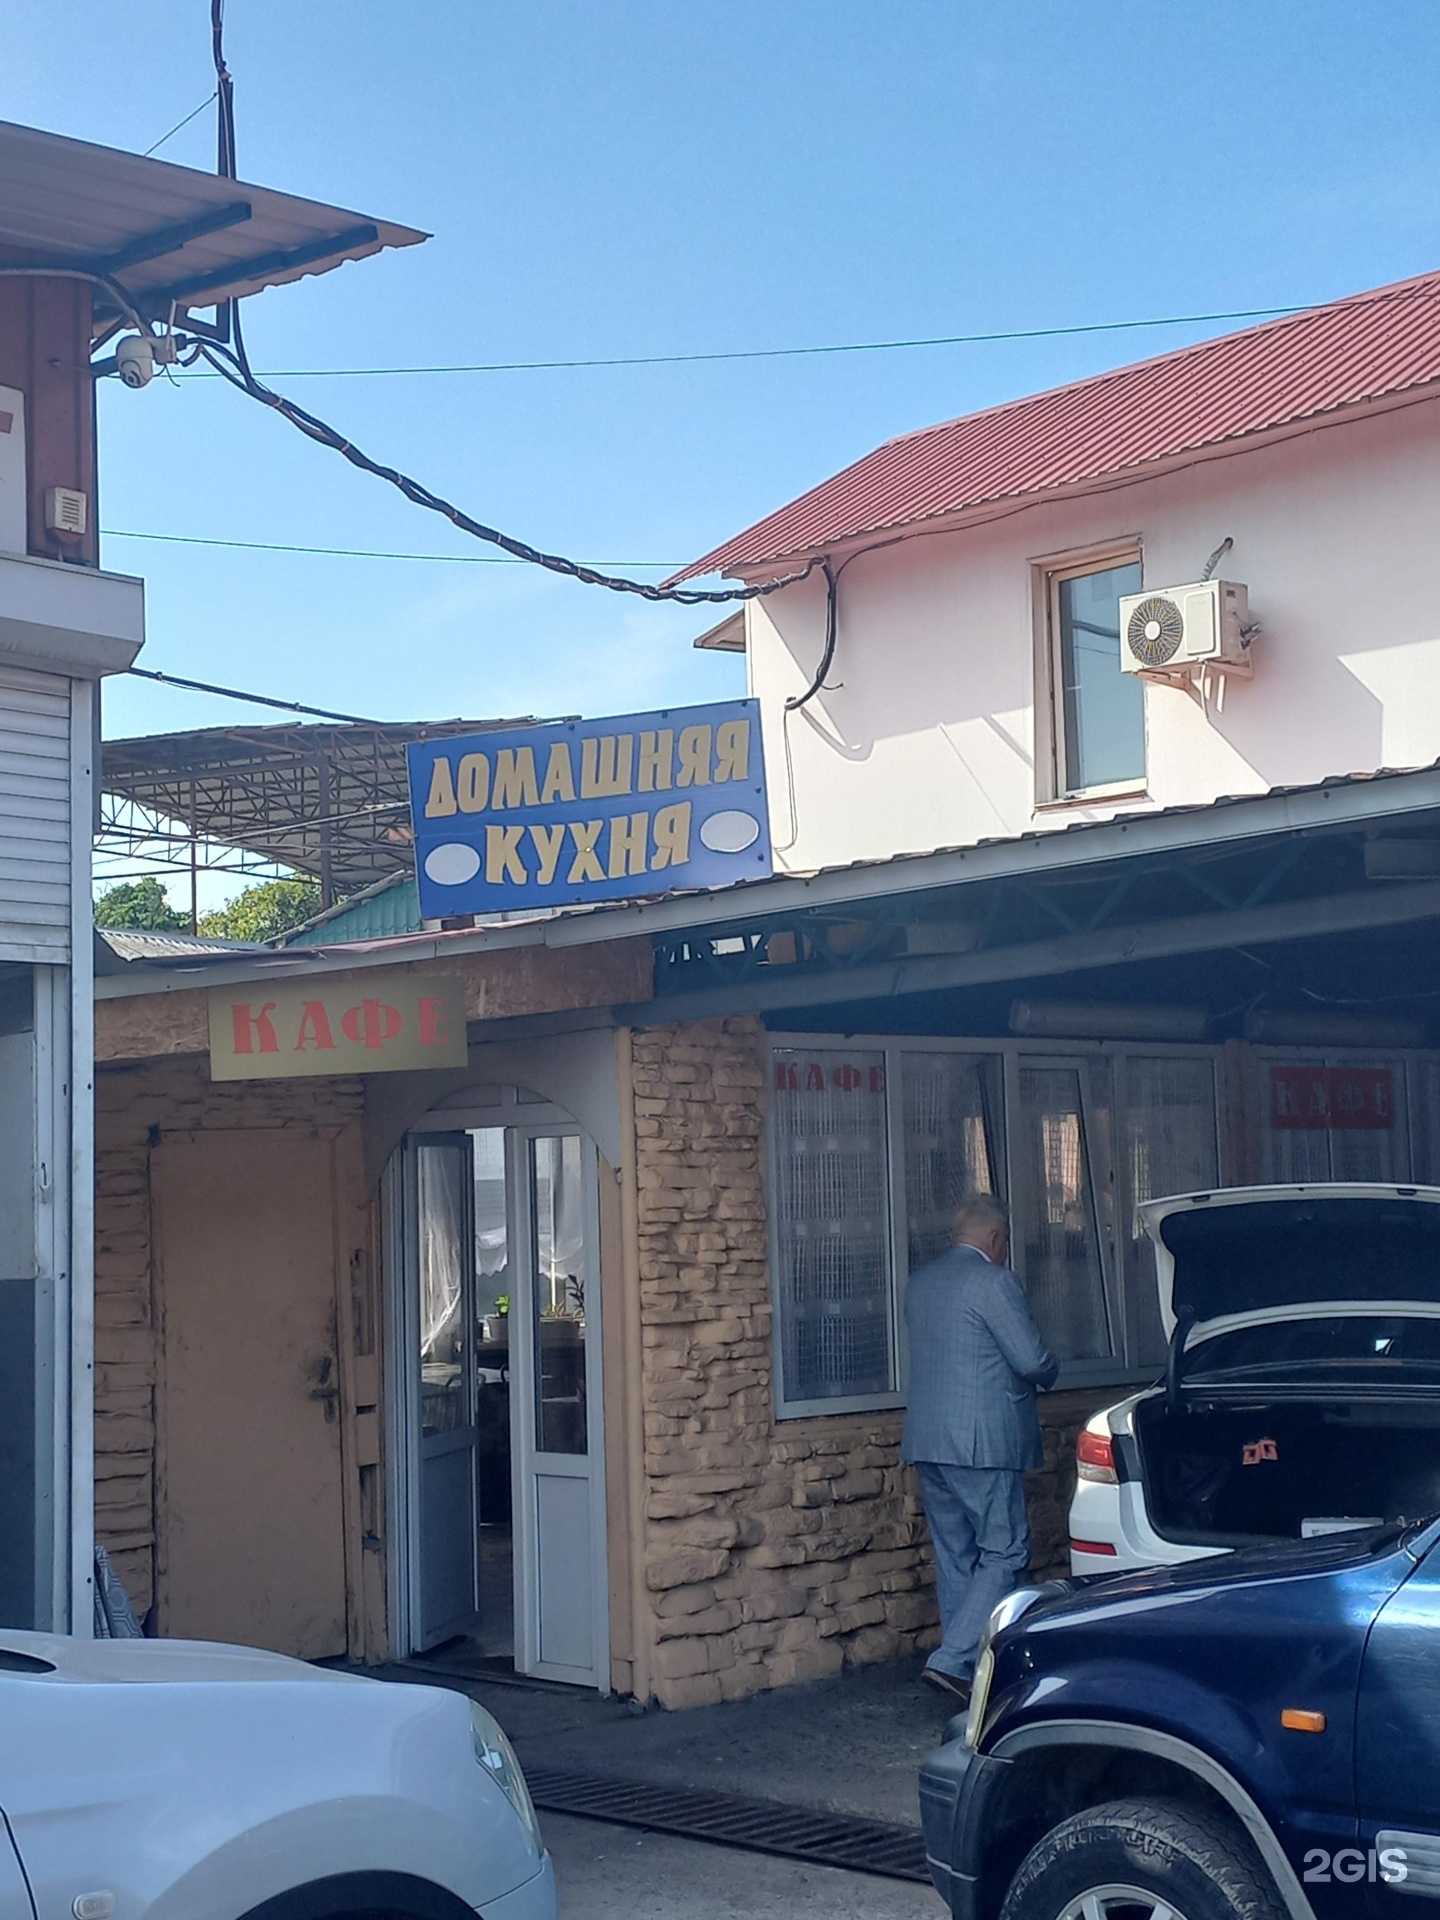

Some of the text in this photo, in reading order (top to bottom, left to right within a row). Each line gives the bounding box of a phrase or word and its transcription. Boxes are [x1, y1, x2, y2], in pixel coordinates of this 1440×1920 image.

[424, 719, 752, 818] ДОМАШНЯЯ
[485, 801, 692, 885] КУХНЯ
[231, 997, 449, 1054] КАФЕ
[776, 1062, 884, 1092] КАФЕ
